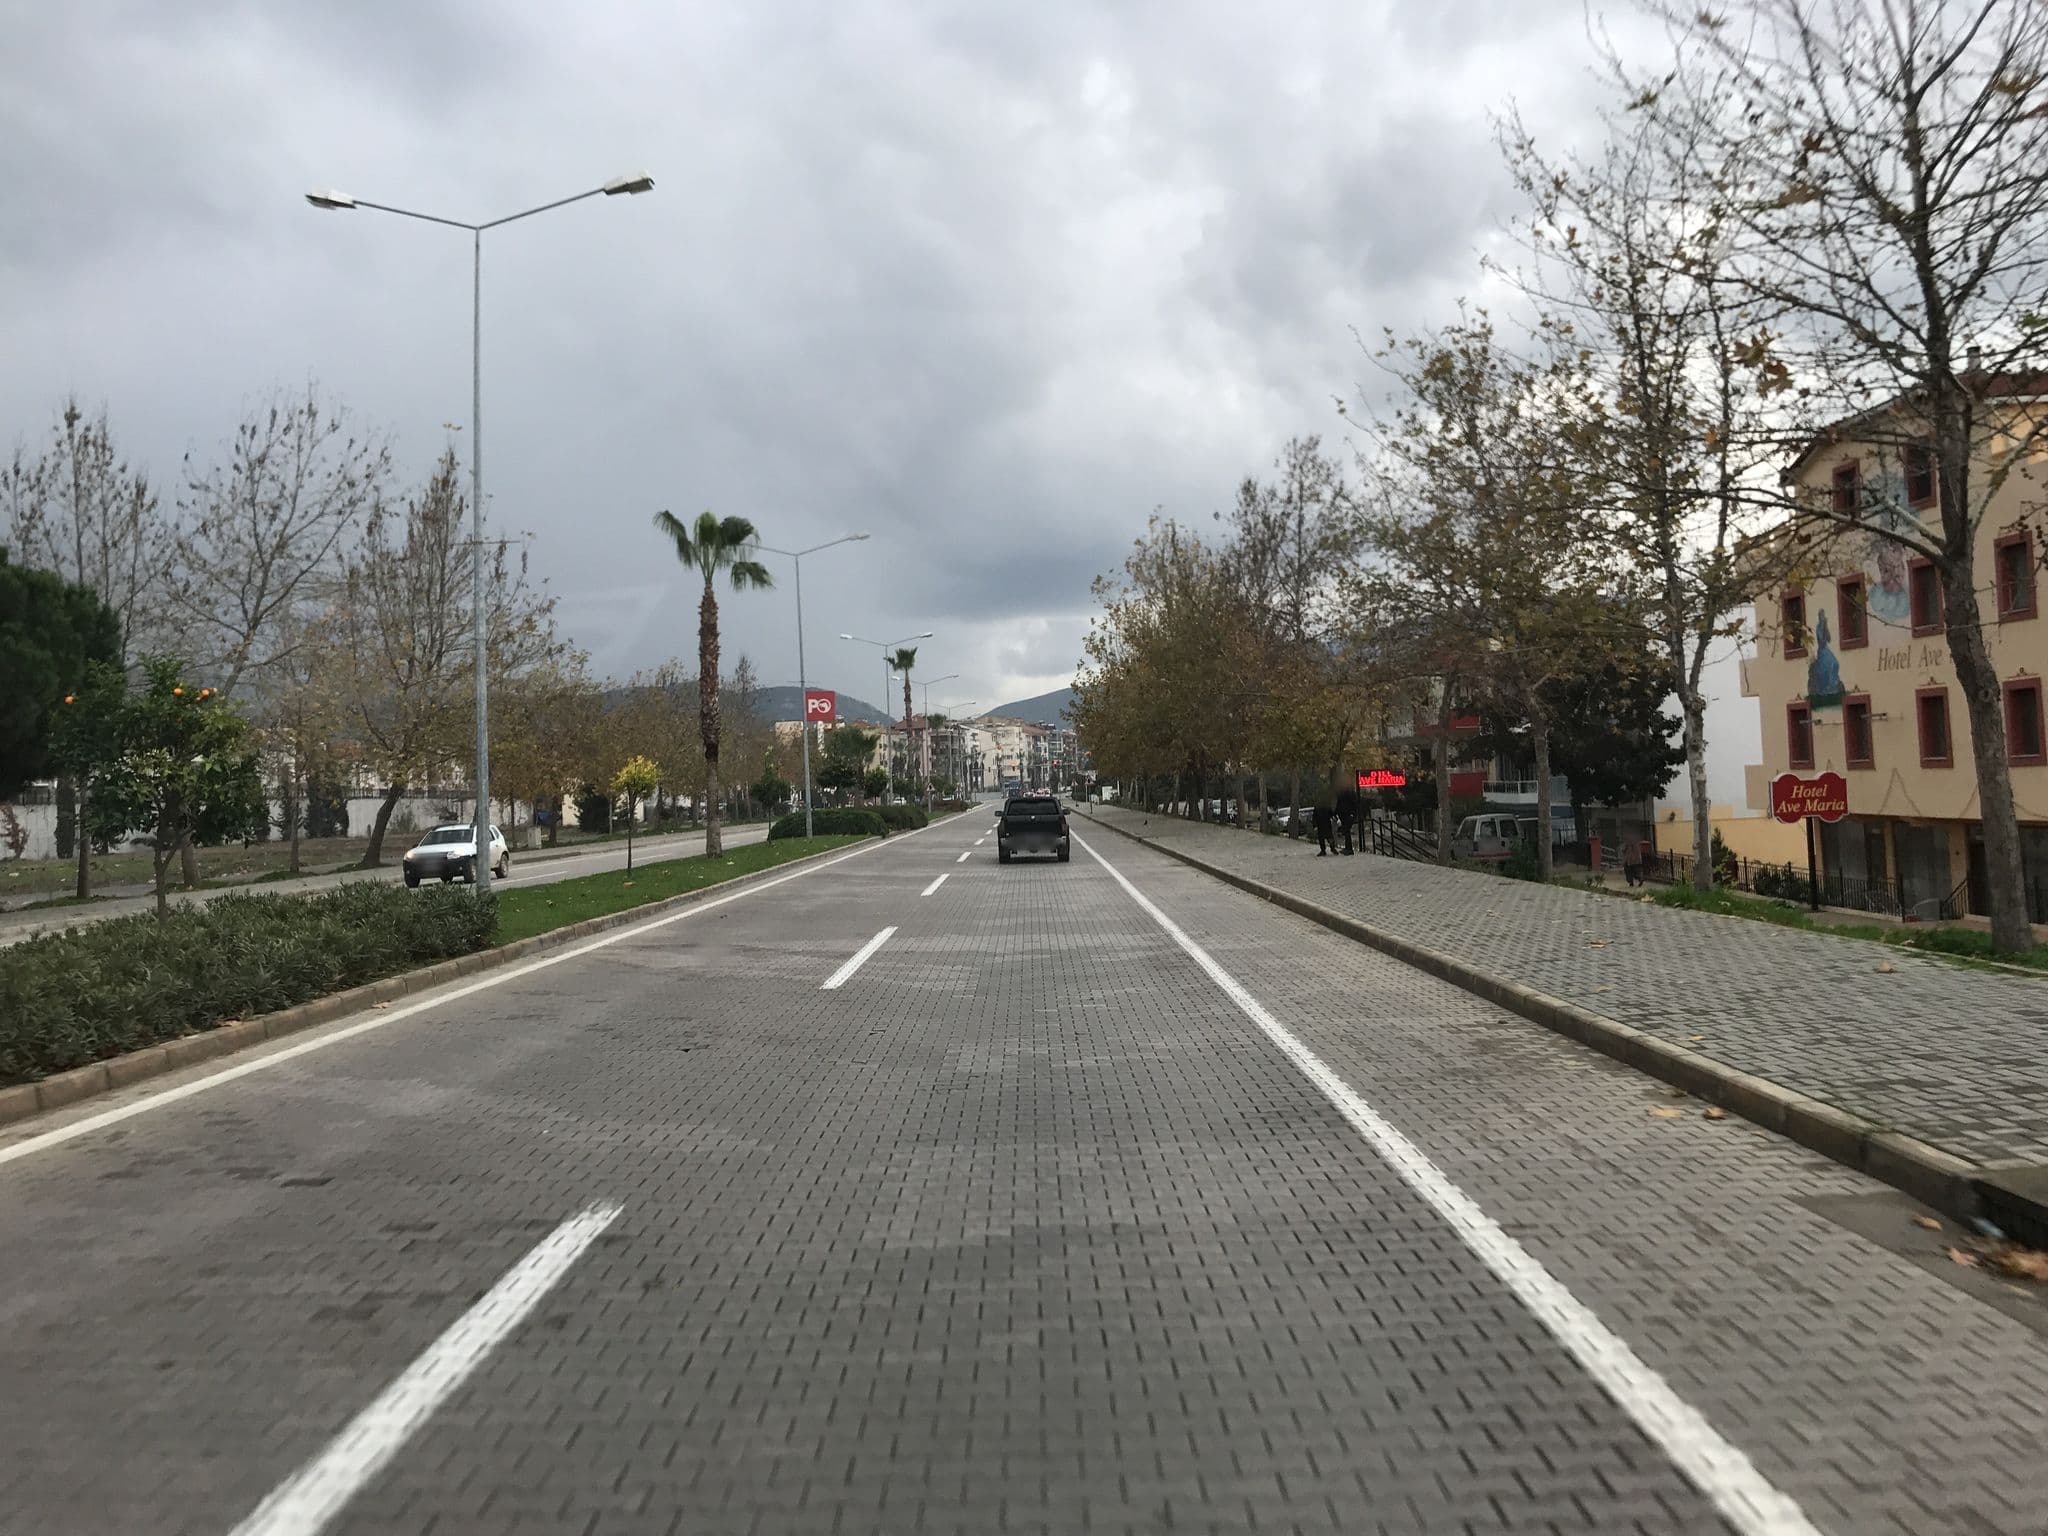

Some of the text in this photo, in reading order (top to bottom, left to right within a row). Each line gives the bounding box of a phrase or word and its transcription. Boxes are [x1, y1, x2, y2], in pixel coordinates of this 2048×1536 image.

[1878, 645, 1912, 672] Hotel
[1919, 644, 1943, 667] Ave
[1791, 784, 1828, 799] Hotel
[1776, 799, 1845, 813] Ave Maria
